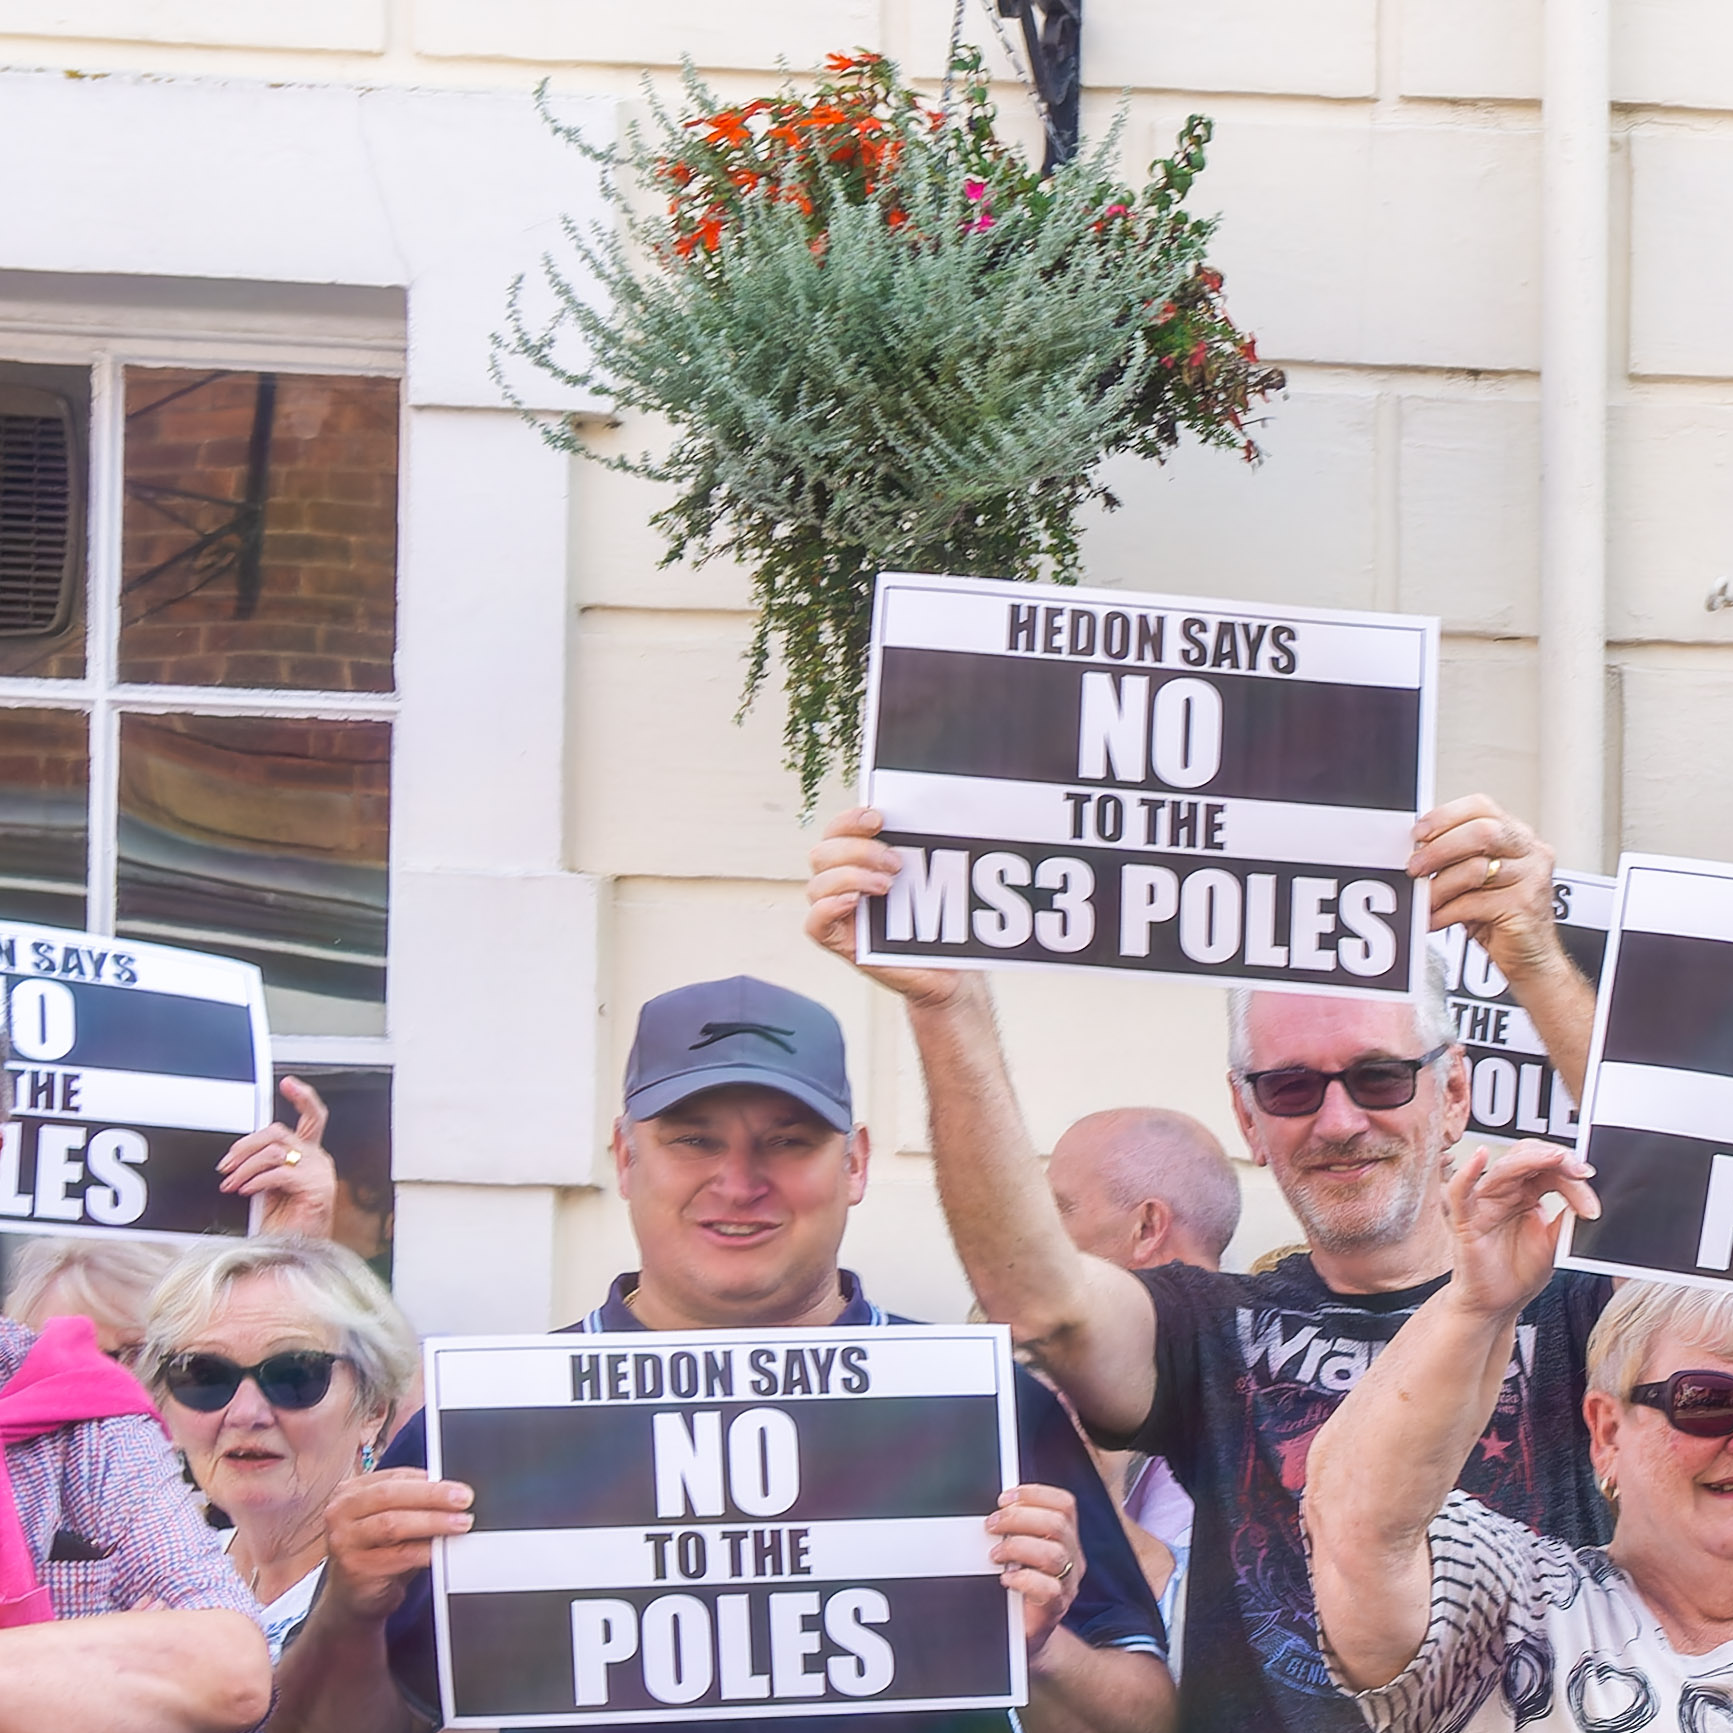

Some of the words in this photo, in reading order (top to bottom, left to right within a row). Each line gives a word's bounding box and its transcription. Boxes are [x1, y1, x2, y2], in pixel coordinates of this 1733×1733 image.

[1007, 604, 1164, 663] HEDON
[1180, 619, 1298, 675] SAYS
[1078, 670, 1223, 789] NO
[1066, 792, 1123, 843] TO
[1139, 797, 1226, 851] THE
[884, 846, 1095, 953] MS3
[1119, 862, 1398, 978] POLES
[31, 941, 139, 985] SAYS
[1451, 1001, 1511, 1045] THE
[0, 1120, 149, 1227] LES
[569, 1349, 734, 1402] HEDON
[748, 1345, 870, 1398] SAYS
[652, 1406, 800, 1519] NO
[644, 1531, 706, 1580] TO
[719, 1528, 812, 1578] THE
[570, 1587, 895, 1708] POLES
